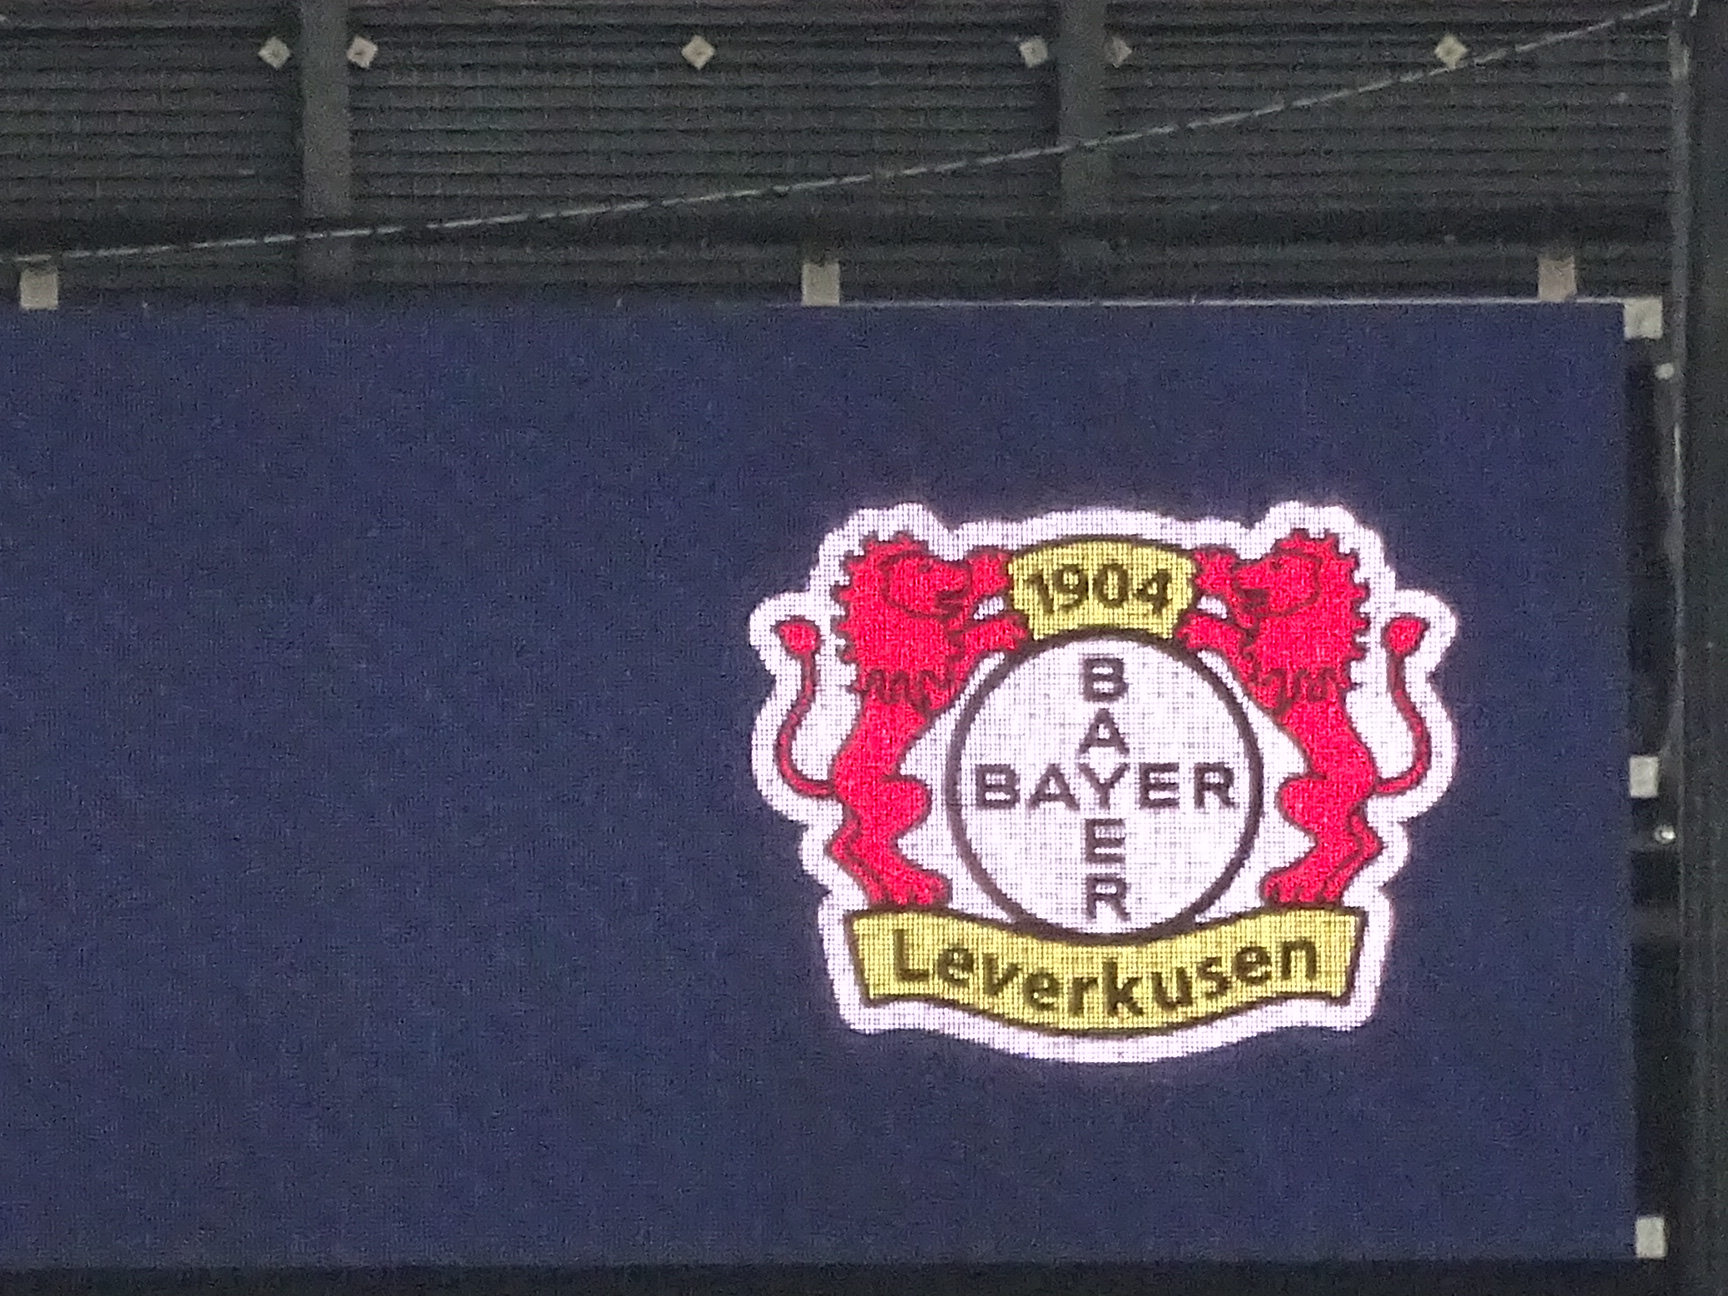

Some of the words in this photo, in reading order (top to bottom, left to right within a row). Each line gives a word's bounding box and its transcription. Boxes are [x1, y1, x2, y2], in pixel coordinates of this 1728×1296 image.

[1025, 562, 1172, 616] 1904
[974, 762, 1237, 811] BAYER
[1081, 657, 1131, 922] BAYER
[892, 927, 1320, 1018] Leverkusen
